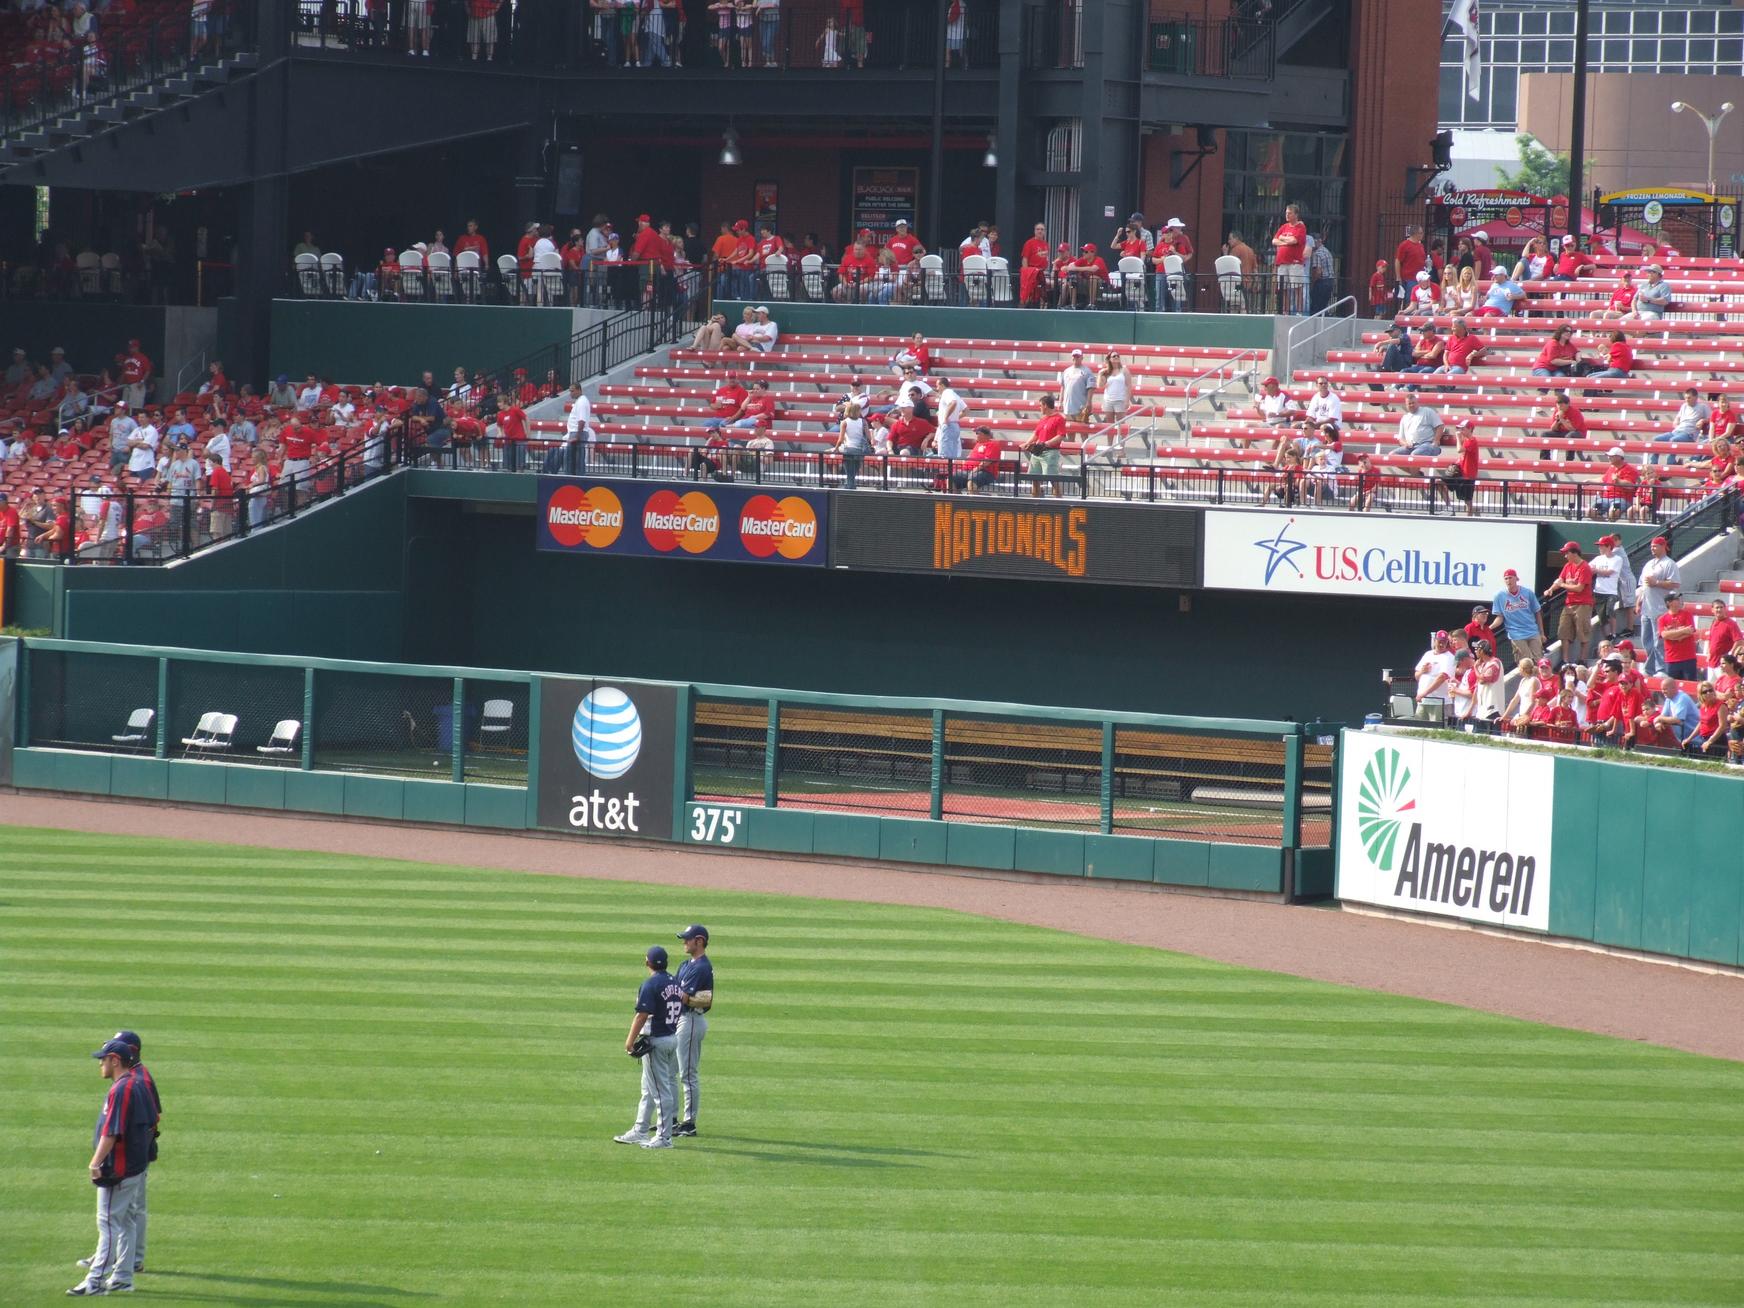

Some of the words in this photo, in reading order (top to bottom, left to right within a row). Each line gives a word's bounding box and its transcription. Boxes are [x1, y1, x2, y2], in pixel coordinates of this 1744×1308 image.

[1442, 192, 1464, 205] Cold
[1466, 192, 1531, 210] Refreshments
[1652, 192, 1686, 200] LEMONADE
[549, 506, 621, 529] MasterCard
[644, 510, 718, 535] MasterCard
[741, 514, 815, 538] MasterCard
[933, 501, 1088, 576] NATIONALS
[1393, 822, 1536, 916] Ameren
